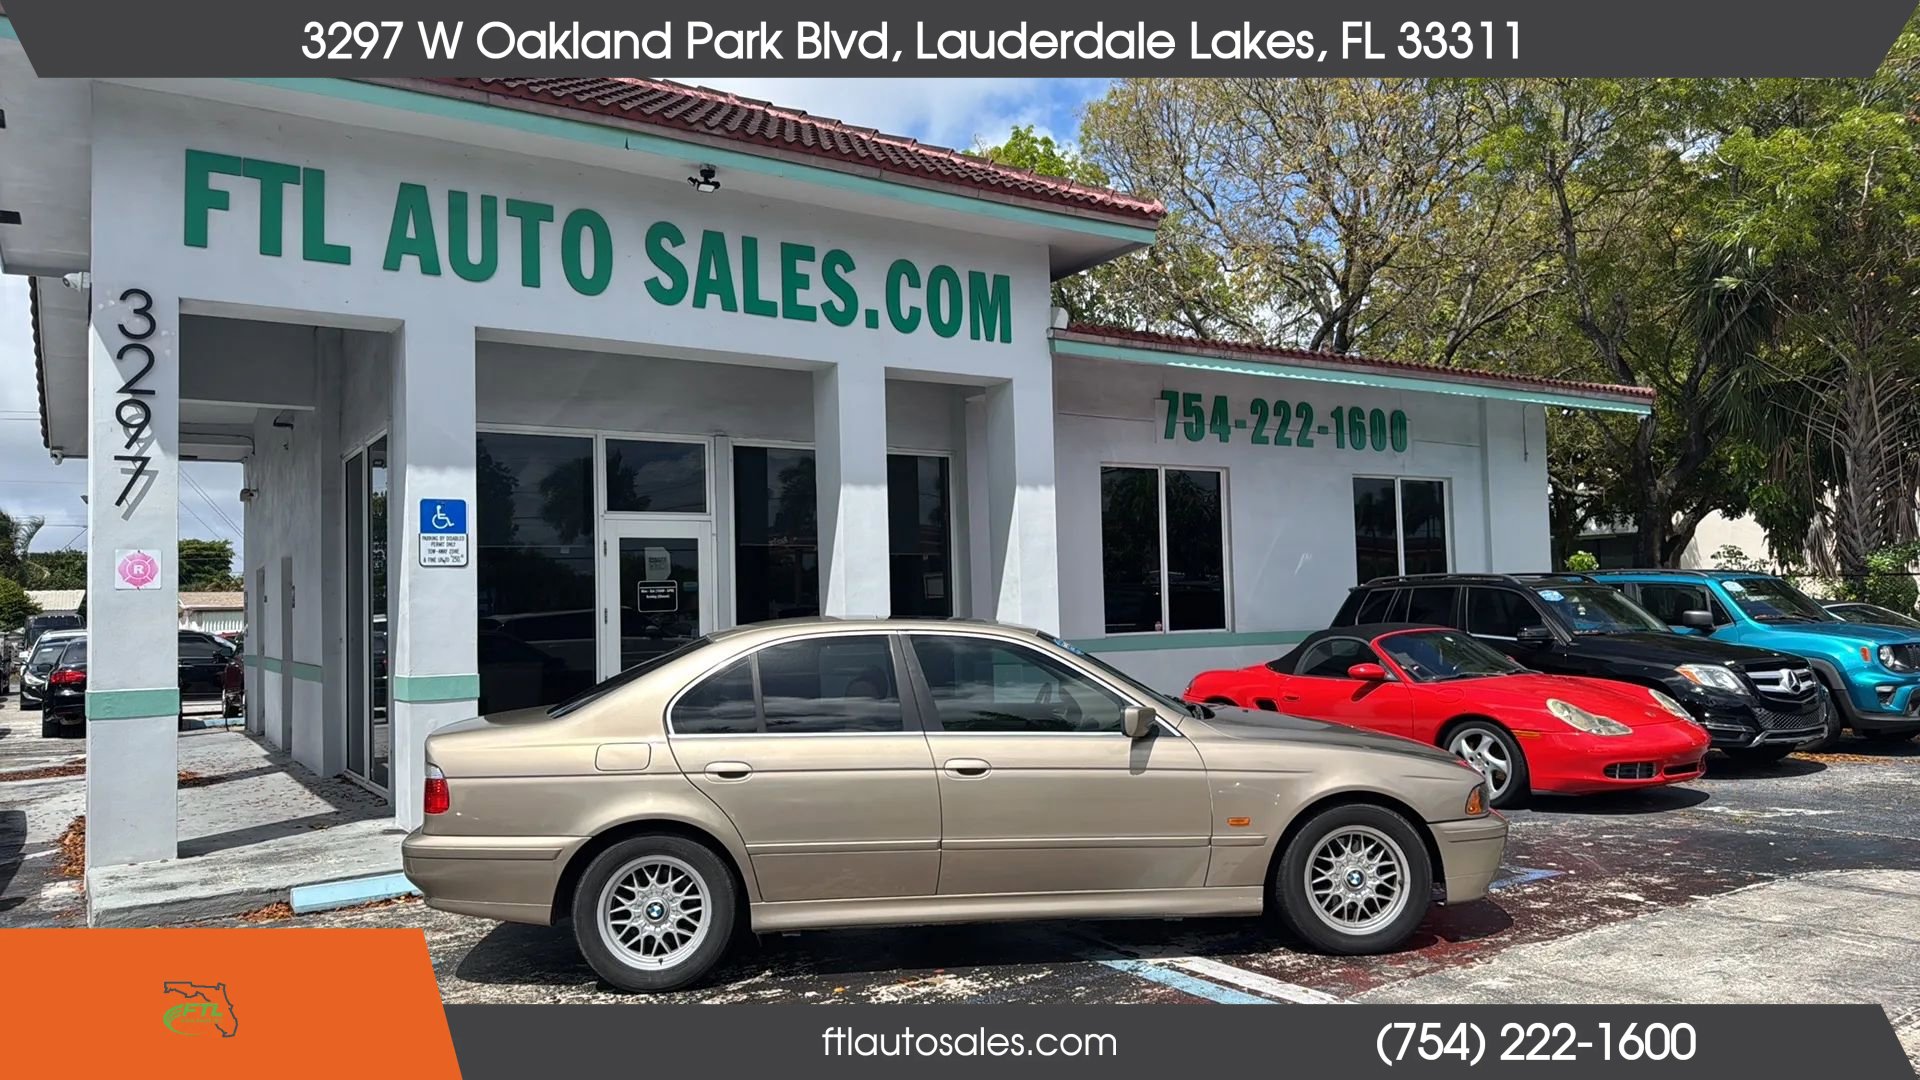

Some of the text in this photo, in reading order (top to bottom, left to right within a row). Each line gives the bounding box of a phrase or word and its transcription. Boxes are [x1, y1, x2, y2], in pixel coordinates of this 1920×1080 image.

[184, 149, 1013, 344] FTL AUTO SALES.COM
[115, 288, 157, 507] 3297
[1160, 389, 1410, 453] 754-222-1600
[133, 564, 145, 575] R
